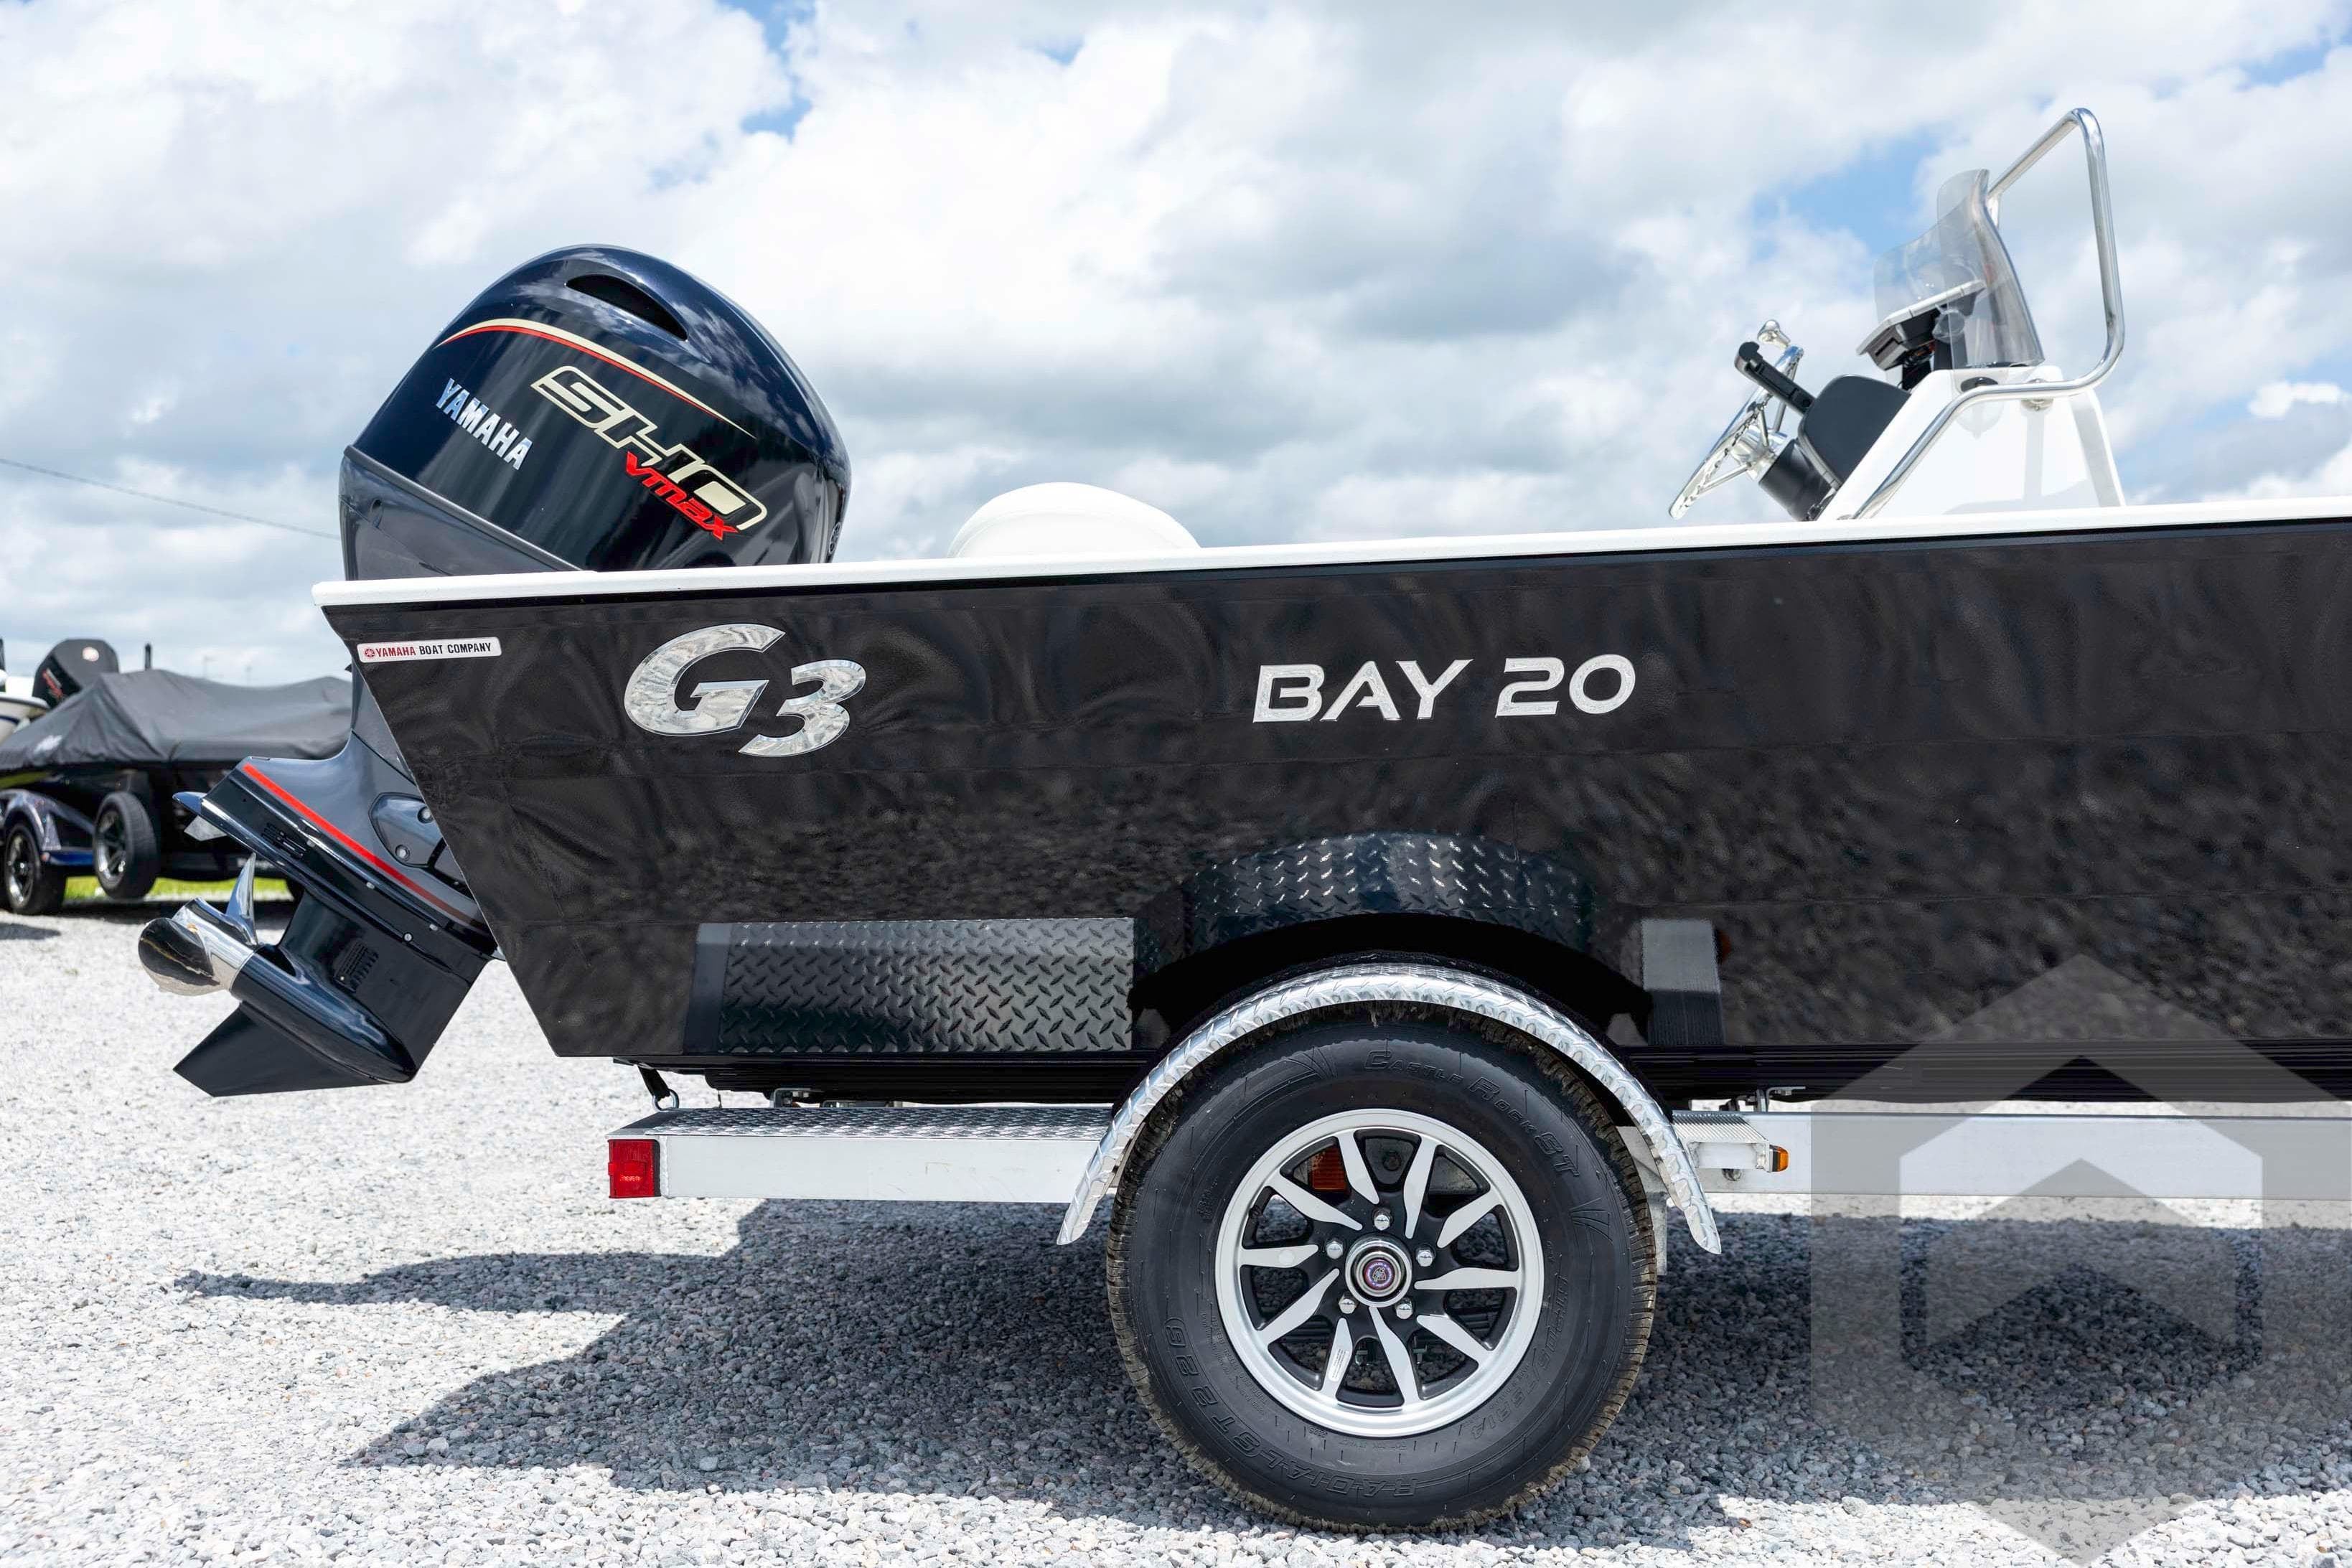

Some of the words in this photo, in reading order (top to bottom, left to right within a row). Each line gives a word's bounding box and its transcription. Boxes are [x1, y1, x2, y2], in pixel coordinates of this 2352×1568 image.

[436, 378, 533, 470] YAMAHA
[530, 365, 768, 531] SHO
[375, 646, 416, 657] YAMAHA
[419, 644, 444, 655] BOAT
[447, 642, 491, 654] COMPANY
[624, 623, 866, 758] G3
[1252, 659, 1473, 723] BAY
[1494, 654, 1636, 718] 20
[1364, 1050, 1464, 1084] CASTLE
[1468, 1076, 1537, 1131] ROCK
[1534, 1132, 1579, 1177] ST
[1260, 1450, 1420, 1497] RADIAL
